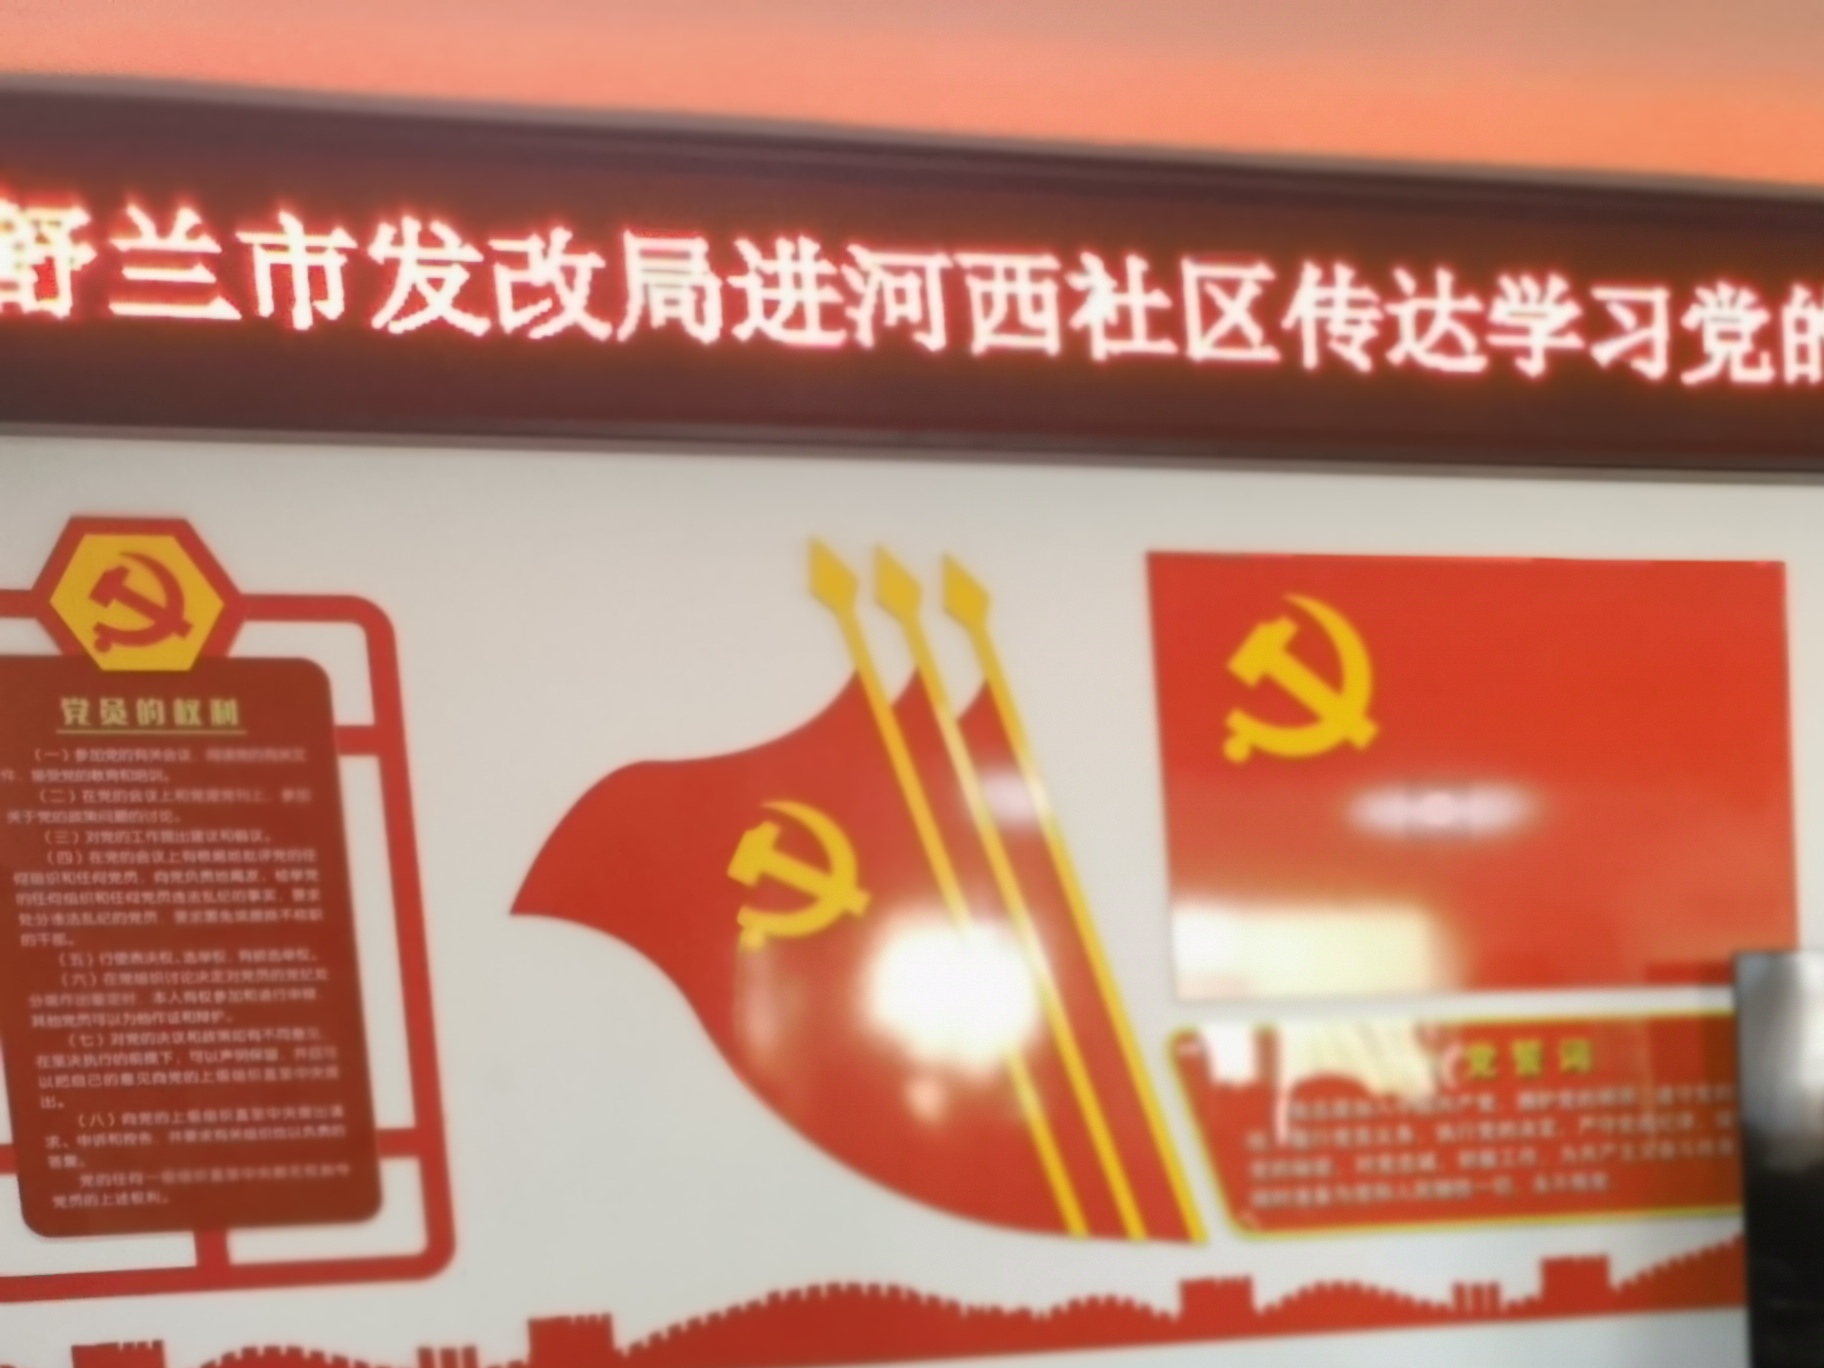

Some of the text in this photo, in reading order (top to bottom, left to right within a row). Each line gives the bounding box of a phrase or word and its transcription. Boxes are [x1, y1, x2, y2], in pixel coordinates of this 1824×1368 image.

[60, 697, 240, 727] 党员的权利
